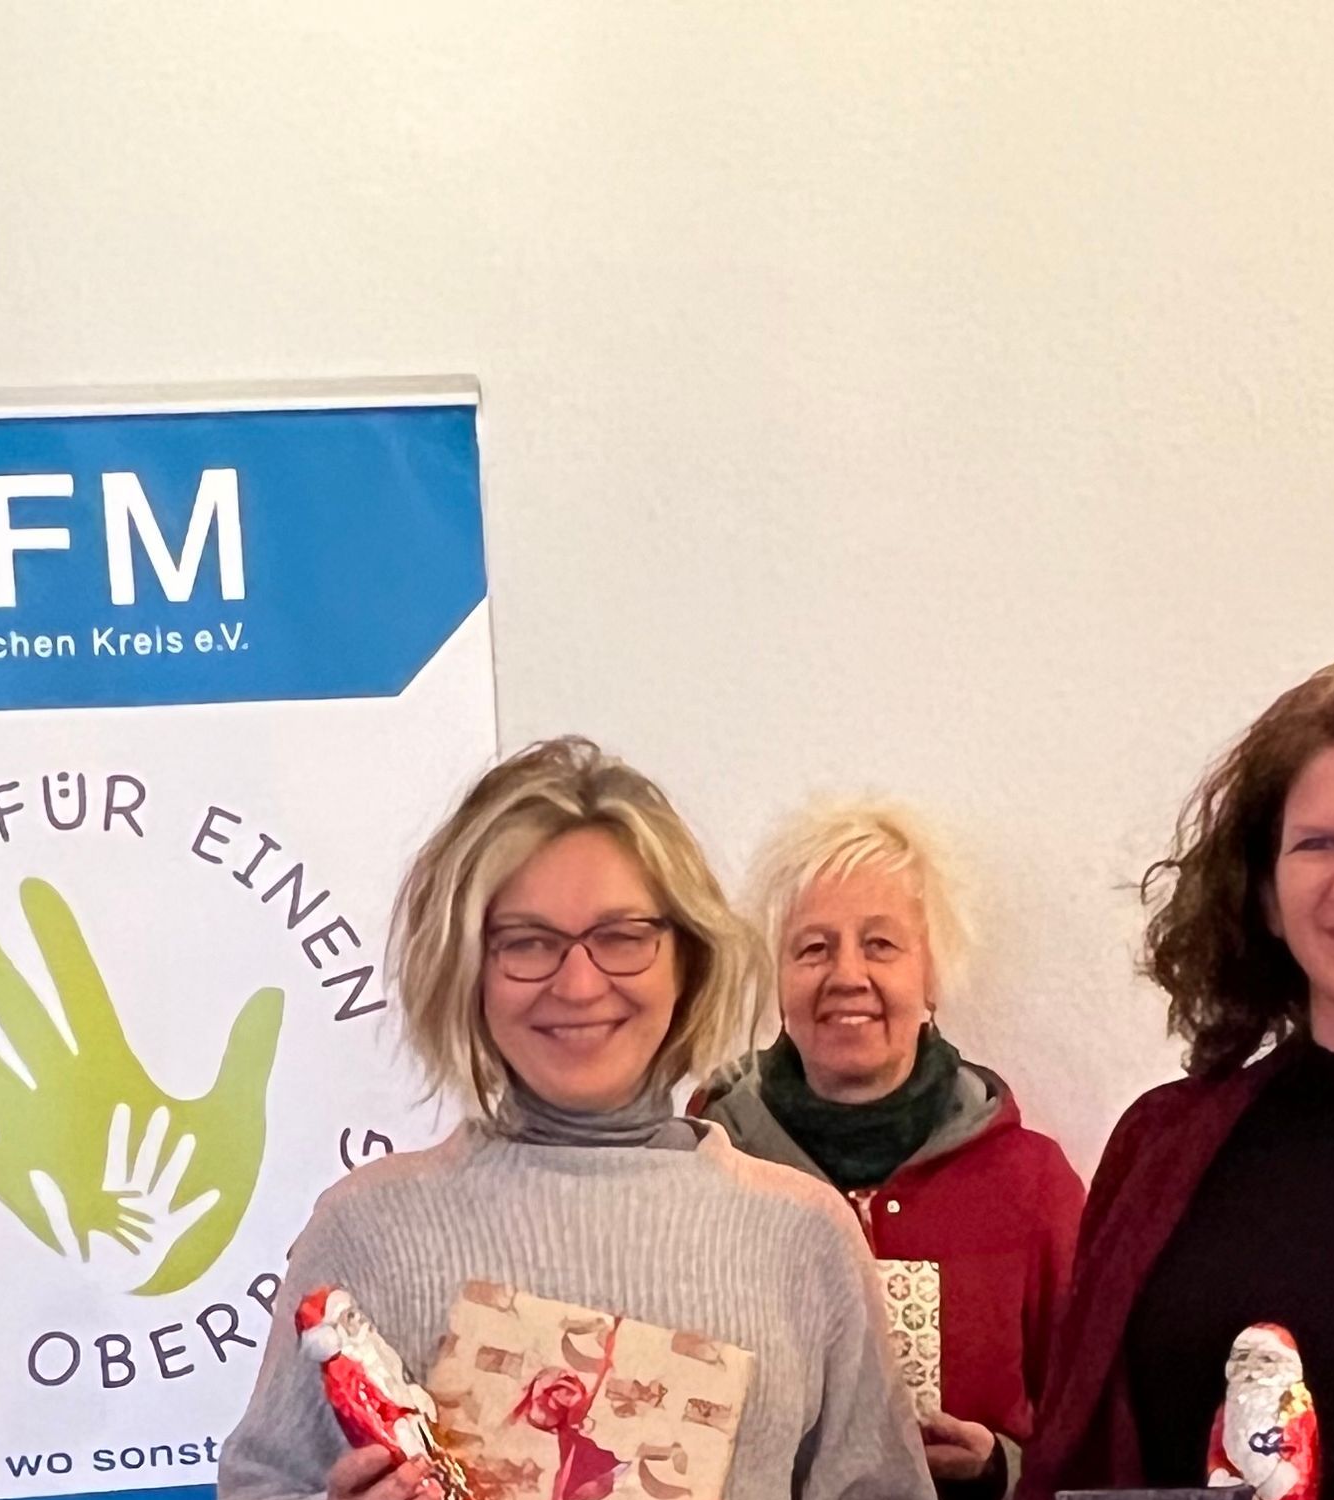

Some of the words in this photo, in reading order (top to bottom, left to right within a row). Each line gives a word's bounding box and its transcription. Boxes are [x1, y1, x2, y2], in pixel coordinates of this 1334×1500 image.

[92, 624, 184, 657] Kreis
[194, 622, 250, 653] e.V.
[191, 806, 386, 1023] EINEN
[5, 1449, 74, 1477] wo
[92, 1436, 220, 1472] sonst
